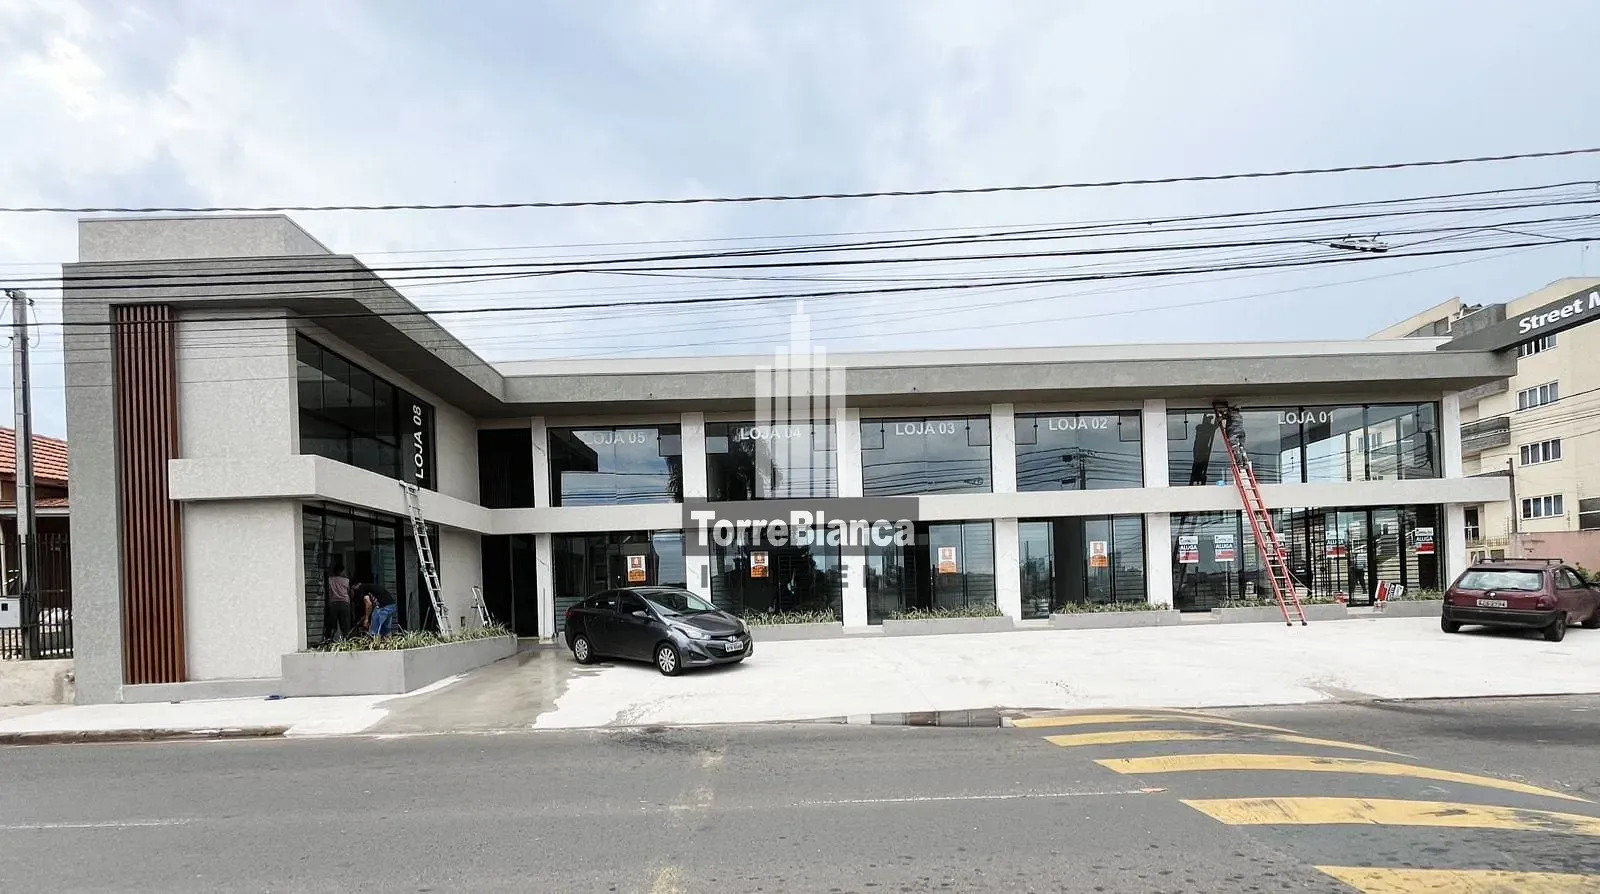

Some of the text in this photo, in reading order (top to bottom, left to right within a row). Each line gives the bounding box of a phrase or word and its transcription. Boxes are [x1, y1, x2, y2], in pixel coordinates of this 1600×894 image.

[1519, 298, 1583, 334] Street
[1048, 417, 1108, 431] LOJA 02
[1278, 411, 1334, 424] LOJA 01
[740, 426, 802, 440] LOJA 04
[895, 422, 956, 436] LOJA 03
[413, 405, 424, 479] LOJA 08
[583, 431, 646, 445] LOJA 05
